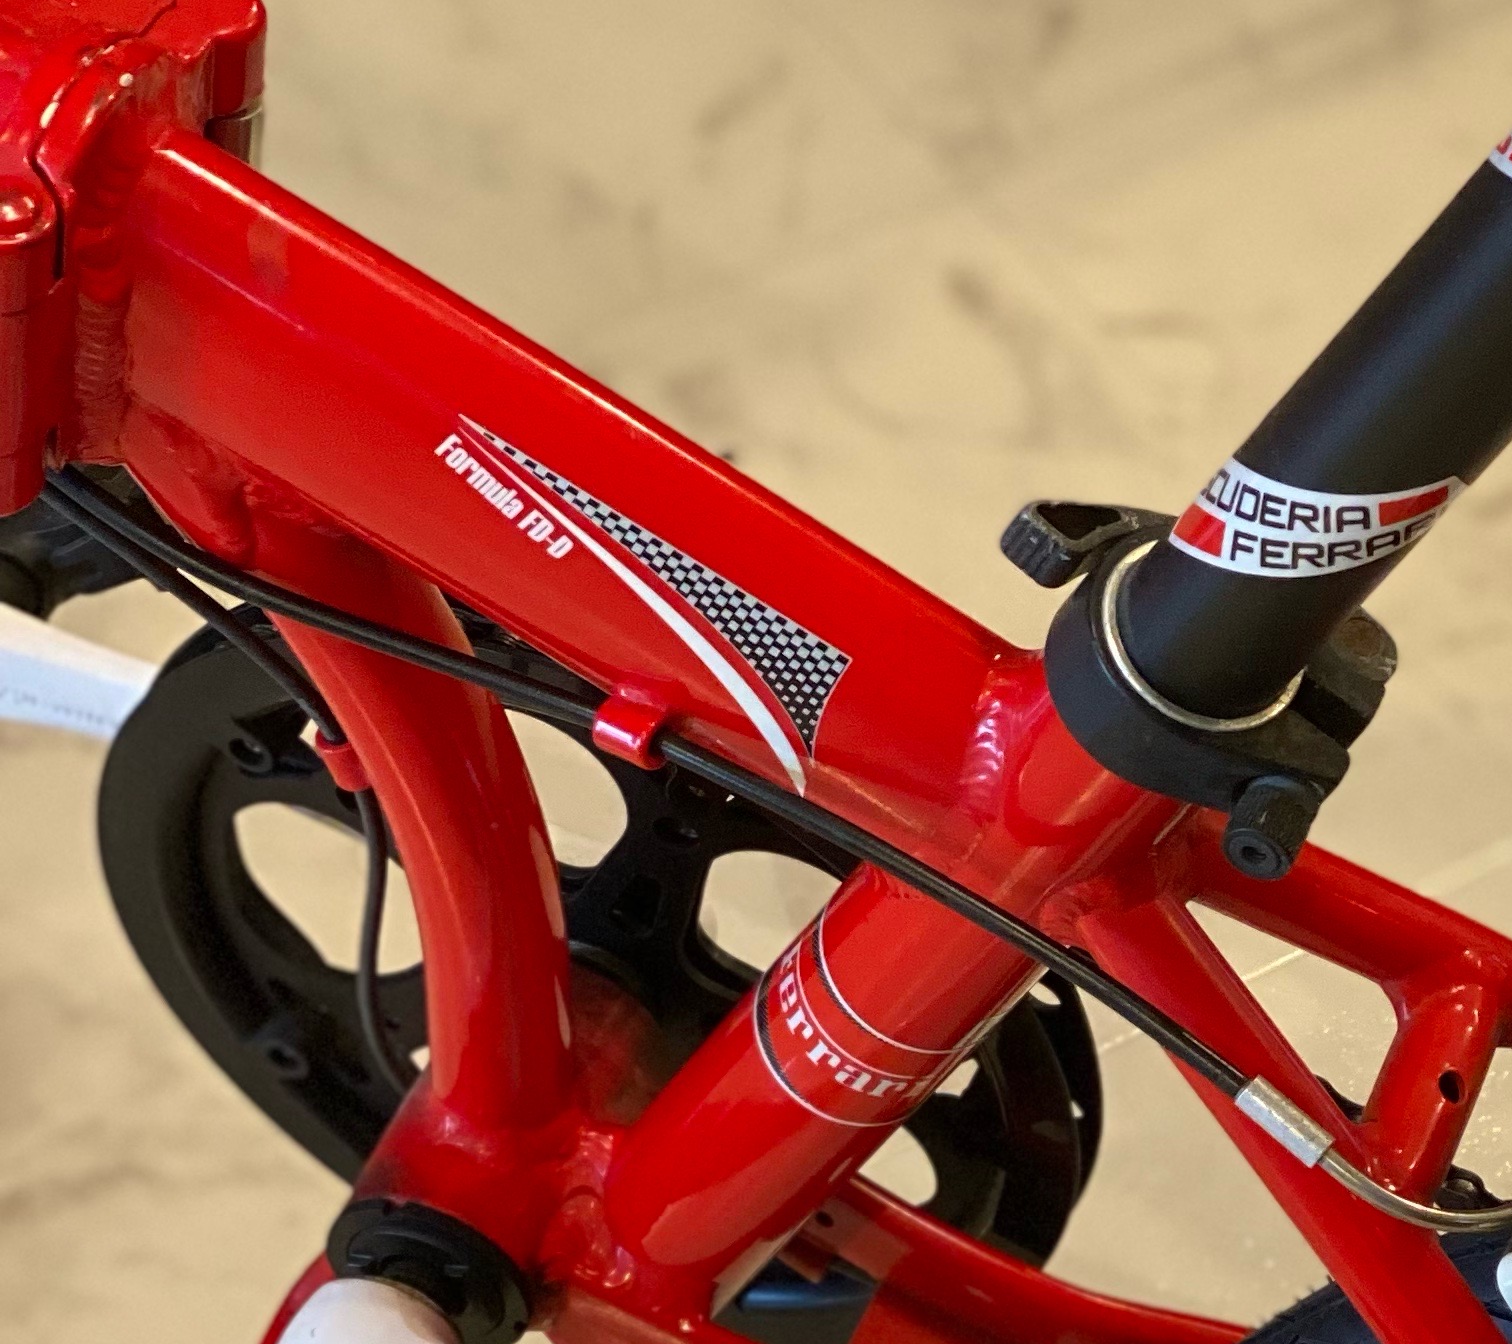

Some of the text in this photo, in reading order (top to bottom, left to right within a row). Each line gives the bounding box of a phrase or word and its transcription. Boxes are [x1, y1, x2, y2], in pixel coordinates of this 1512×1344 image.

[433, 433, 525, 520] Formula
[1200, 468, 1371, 534] CUDERIA
[1230, 503, 1450, 570] FERRAR
